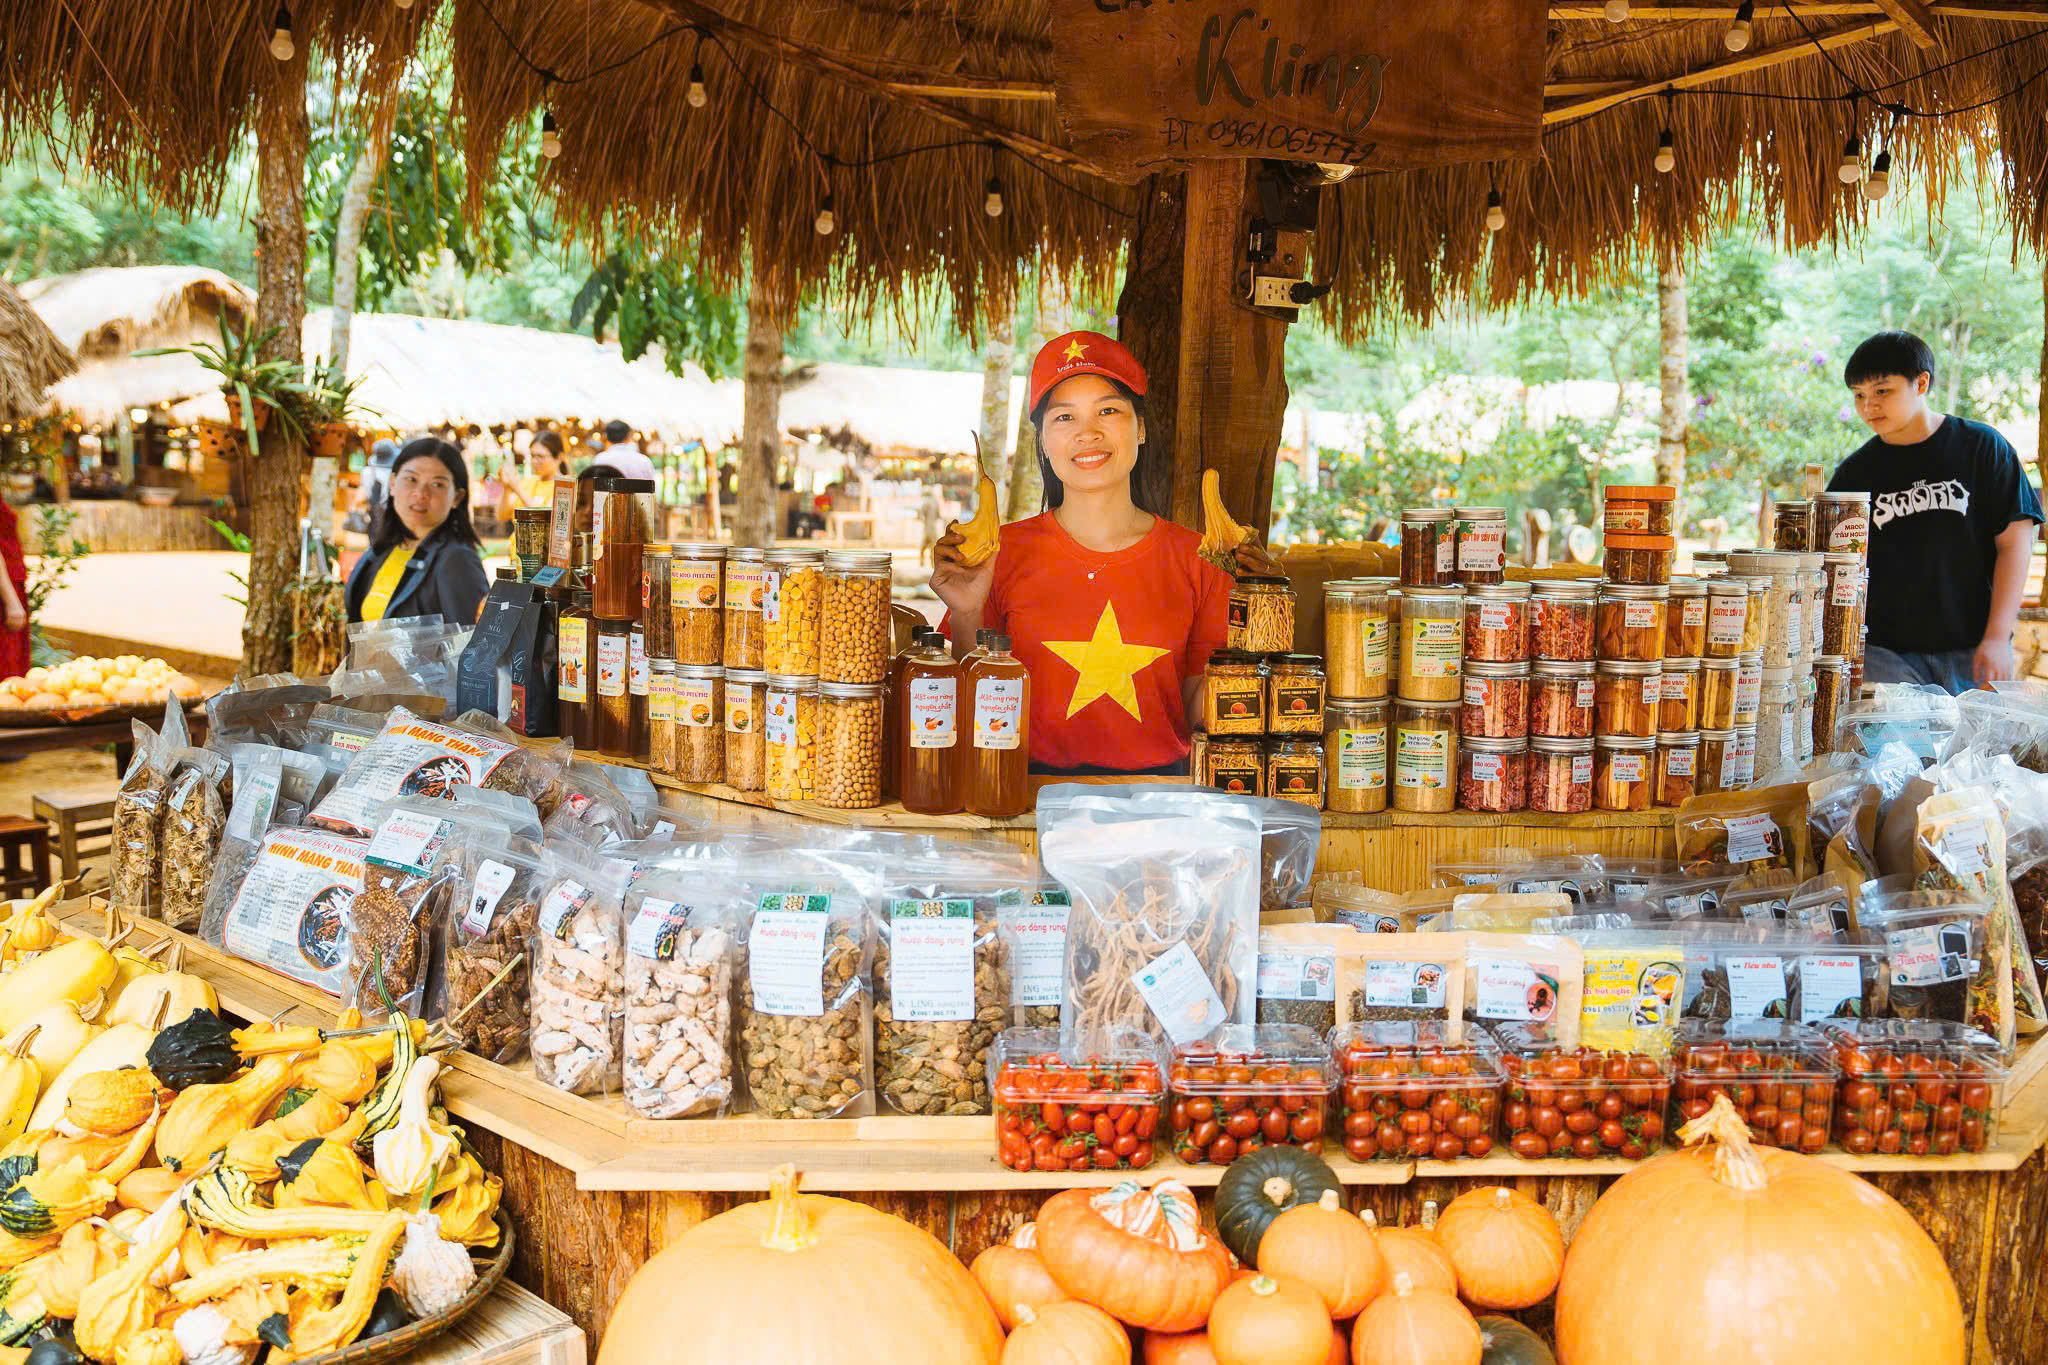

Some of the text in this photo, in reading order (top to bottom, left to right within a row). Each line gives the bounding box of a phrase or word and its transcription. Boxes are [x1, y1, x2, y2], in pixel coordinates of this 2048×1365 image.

[1208, 119, 1376, 163] 0961065779
[1912, 479, 1927, 488] THE
[1872, 479, 1970, 531] SWORD
[267, 842, 299, 860] MINH
[332, 860, 362, 880] THAN
